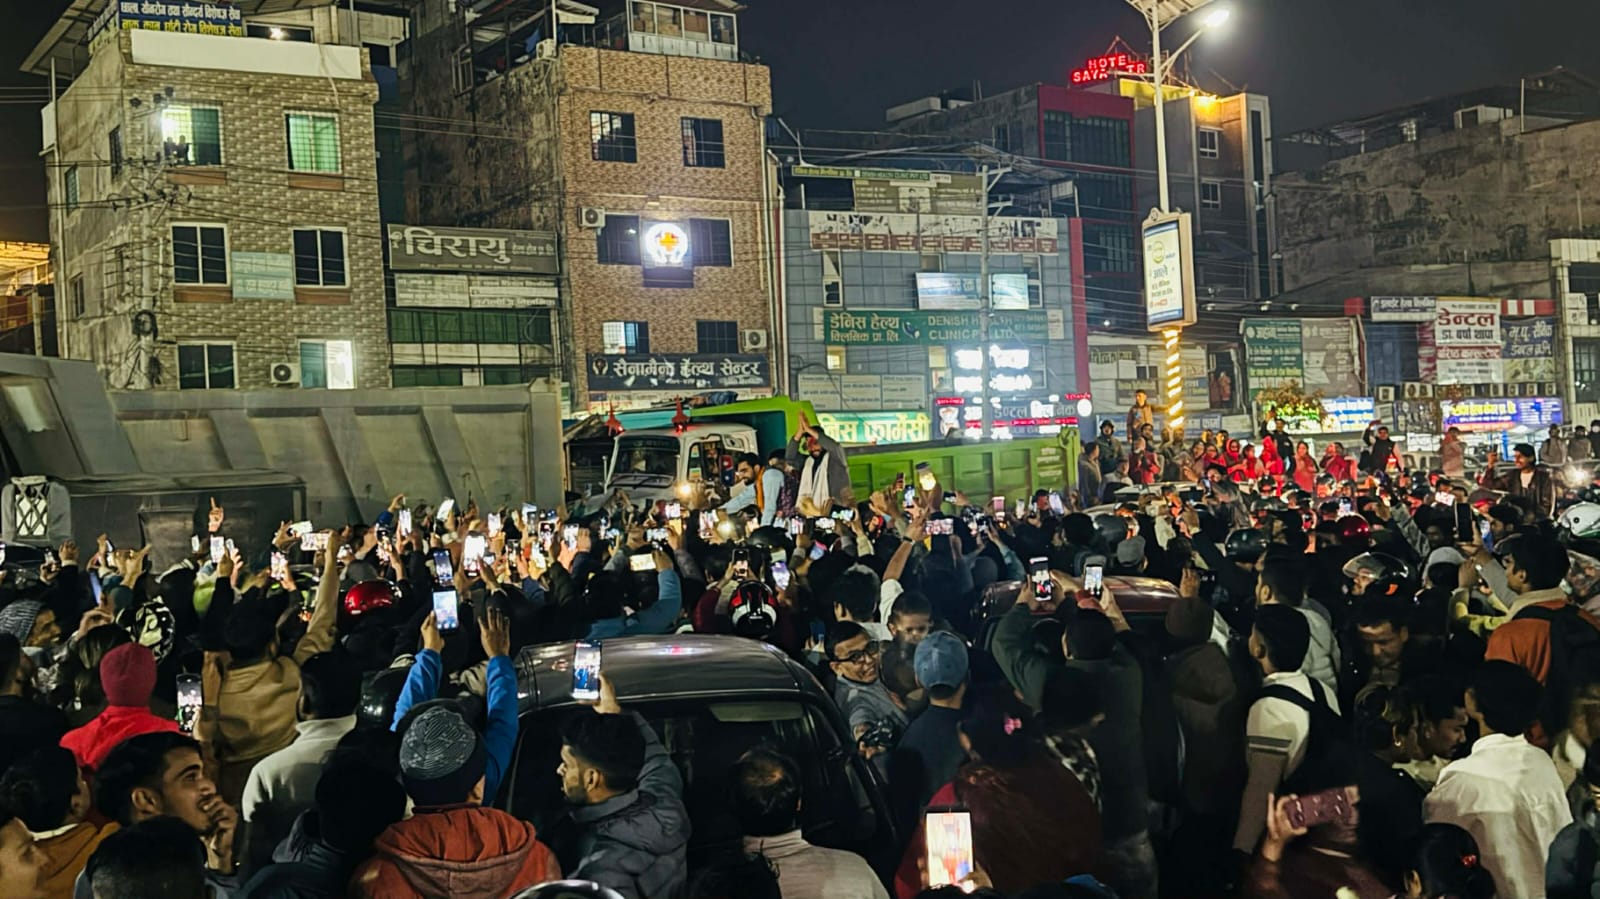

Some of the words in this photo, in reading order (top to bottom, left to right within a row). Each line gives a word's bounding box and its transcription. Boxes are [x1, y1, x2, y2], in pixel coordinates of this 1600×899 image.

[404, 227, 511, 264] चिरायु
[830, 314, 866, 330] डेनिस
[871, 315, 900, 330] हेल्थ
[927, 315, 968, 327] DENISH
[1438, 308, 1495, 327] डेन्टल
[830, 330, 869, 343] क्लिनिक
[928, 329, 970, 341] CLINIC
[719, 357, 761, 377] सेन्टर
[816, 413, 858, 442] निस
[864, 412, 930, 442] फार्मेसी
